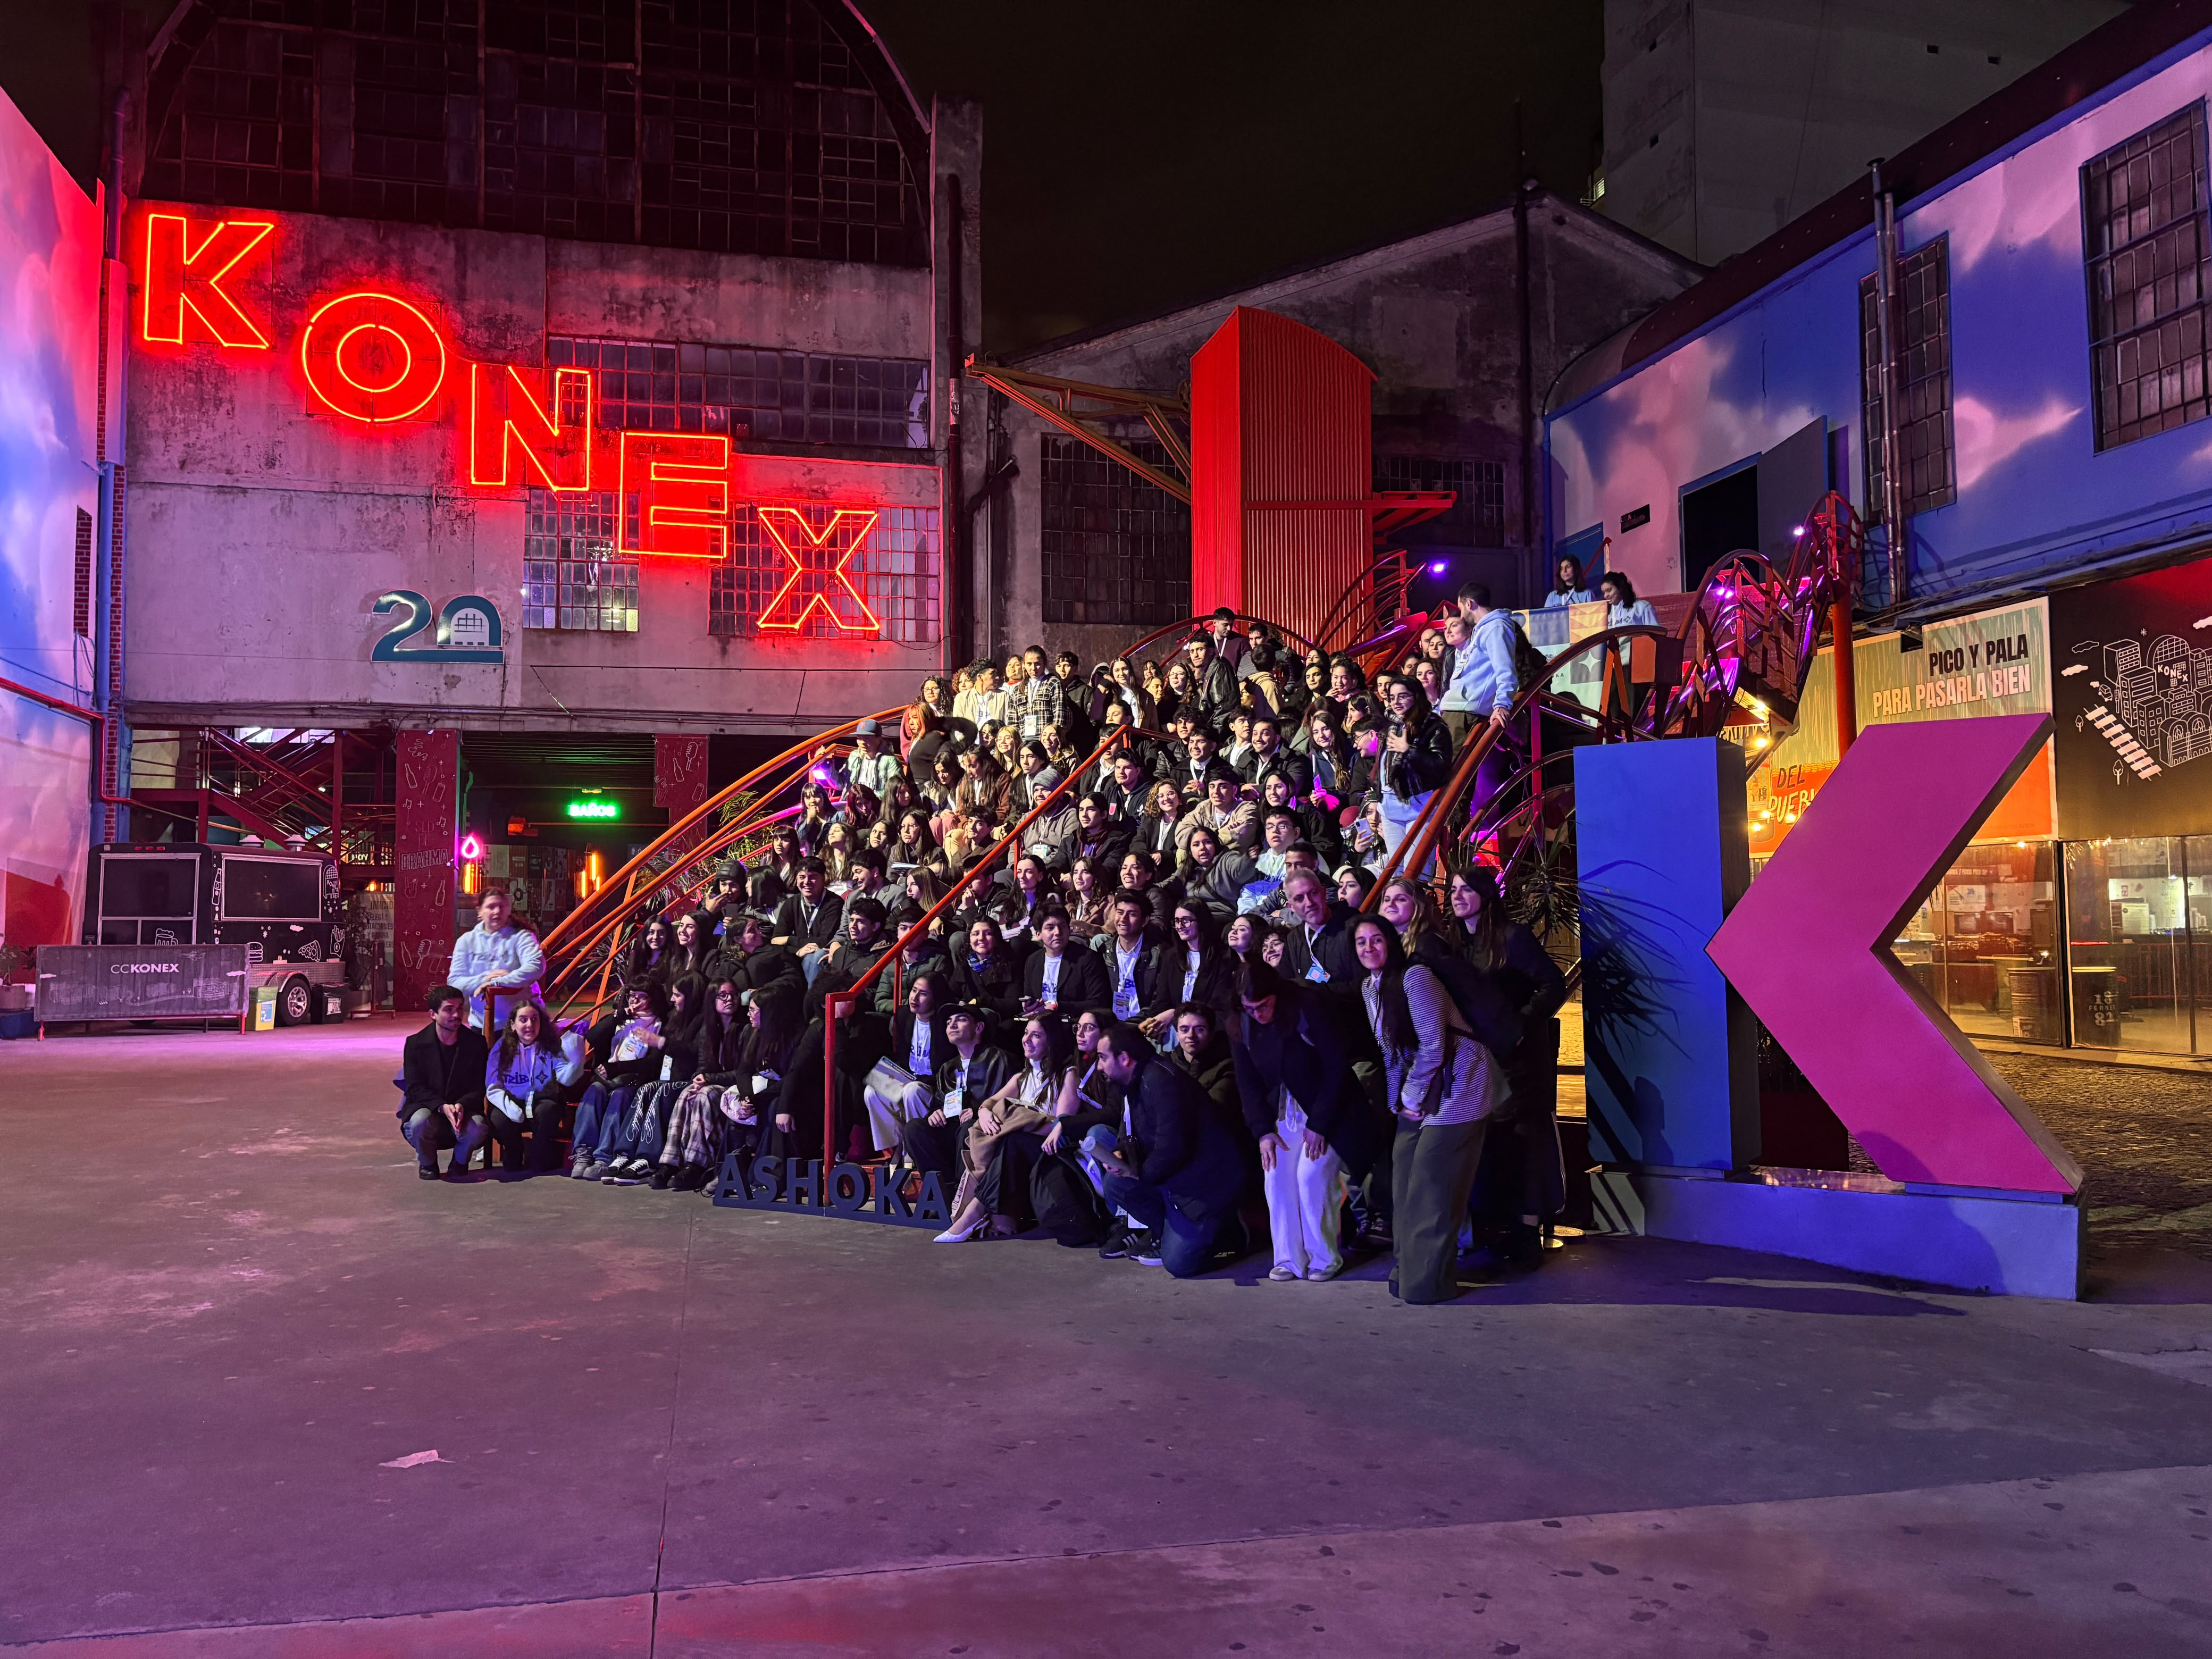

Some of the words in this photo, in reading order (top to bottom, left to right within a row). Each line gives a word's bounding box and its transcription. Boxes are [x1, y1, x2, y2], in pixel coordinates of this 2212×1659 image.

[143, 214, 880, 632] KONEX
[1929, 647, 1964, 676] PICO
[1969, 644, 1979, 668] Y
[1986, 634, 2029, 665] PALA
[2158, 665, 2188, 682] KONEX
[1873, 686, 1912, 717] PARA
[1915, 673, 1987, 710] PASARLA
[1992, 664, 2030, 698] BIEN
[1777, 765, 1805, 789] DEL
[569, 802, 616, 816] BAÑOS
[401, 849, 448, 870] BRAHMA
[111, 963, 179, 974] CCKONEX
[715, 1153, 952, 1225] ASHOKA
